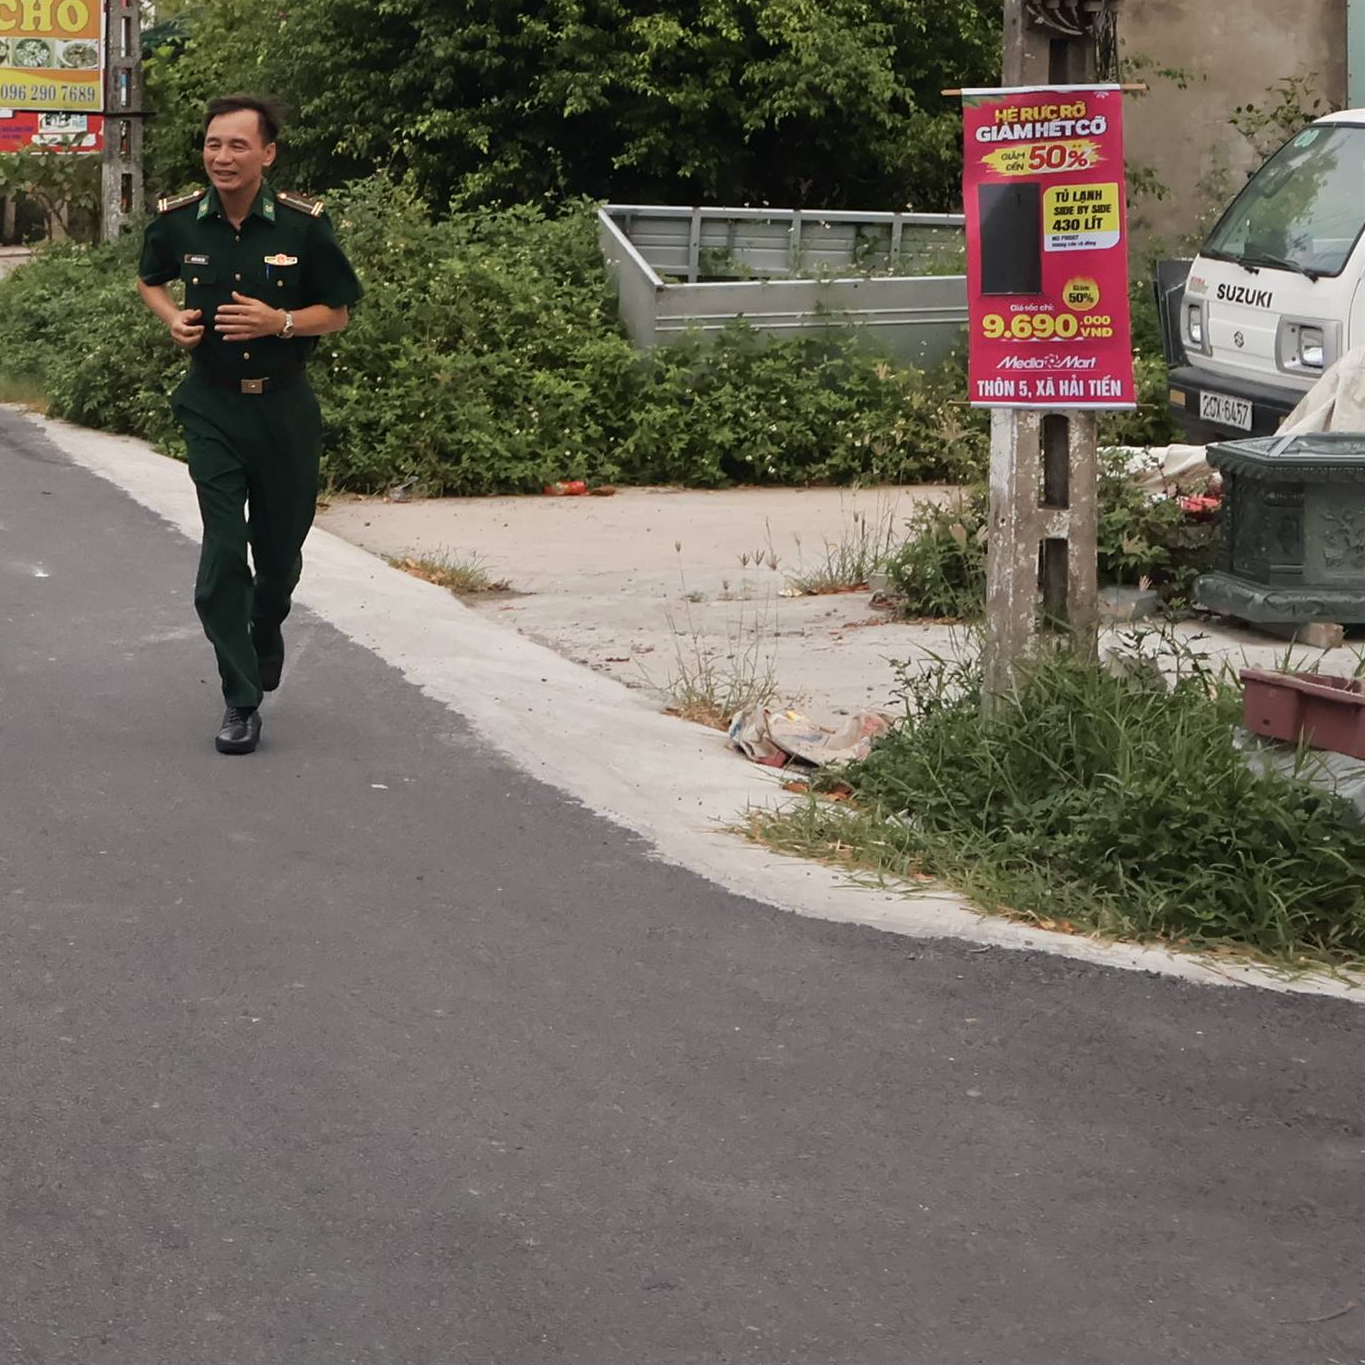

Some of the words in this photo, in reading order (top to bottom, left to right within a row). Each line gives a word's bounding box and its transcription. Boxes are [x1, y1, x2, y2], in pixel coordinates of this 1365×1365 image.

[0, 83, 26, 101] 096
[30, 84, 56, 101] 290
[60, 85, 95, 102] 7689
[994, 106, 1018, 123] HÈ
[1034, 117, 1077, 138] HẾT
[1028, 144, 1089, 171] 50%
[1055, 189, 1070, 203] TỦ
[1073, 190, 1103, 204] LẠNH
[1053, 206, 1075, 216] SIDE
[1077, 205, 1089, 214] BY
[1091, 204, 1111, 214] SIDE
[1052, 218, 1081, 232] 430
[1084, 215, 1103, 230] LÍT
[1069, 292, 1094, 303] 50%
[1216, 284, 1273, 308] SUZUKI
[982, 313, 1078, 338] 9.690
[977, 377, 1015, 397] THÔN
[1019, 380, 1032, 398] 5,
[1036, 377, 1055, 396] XÃ
[1059, 375, 1084, 396] HẢI
[1088, 375, 1122, 396] TIẾN
